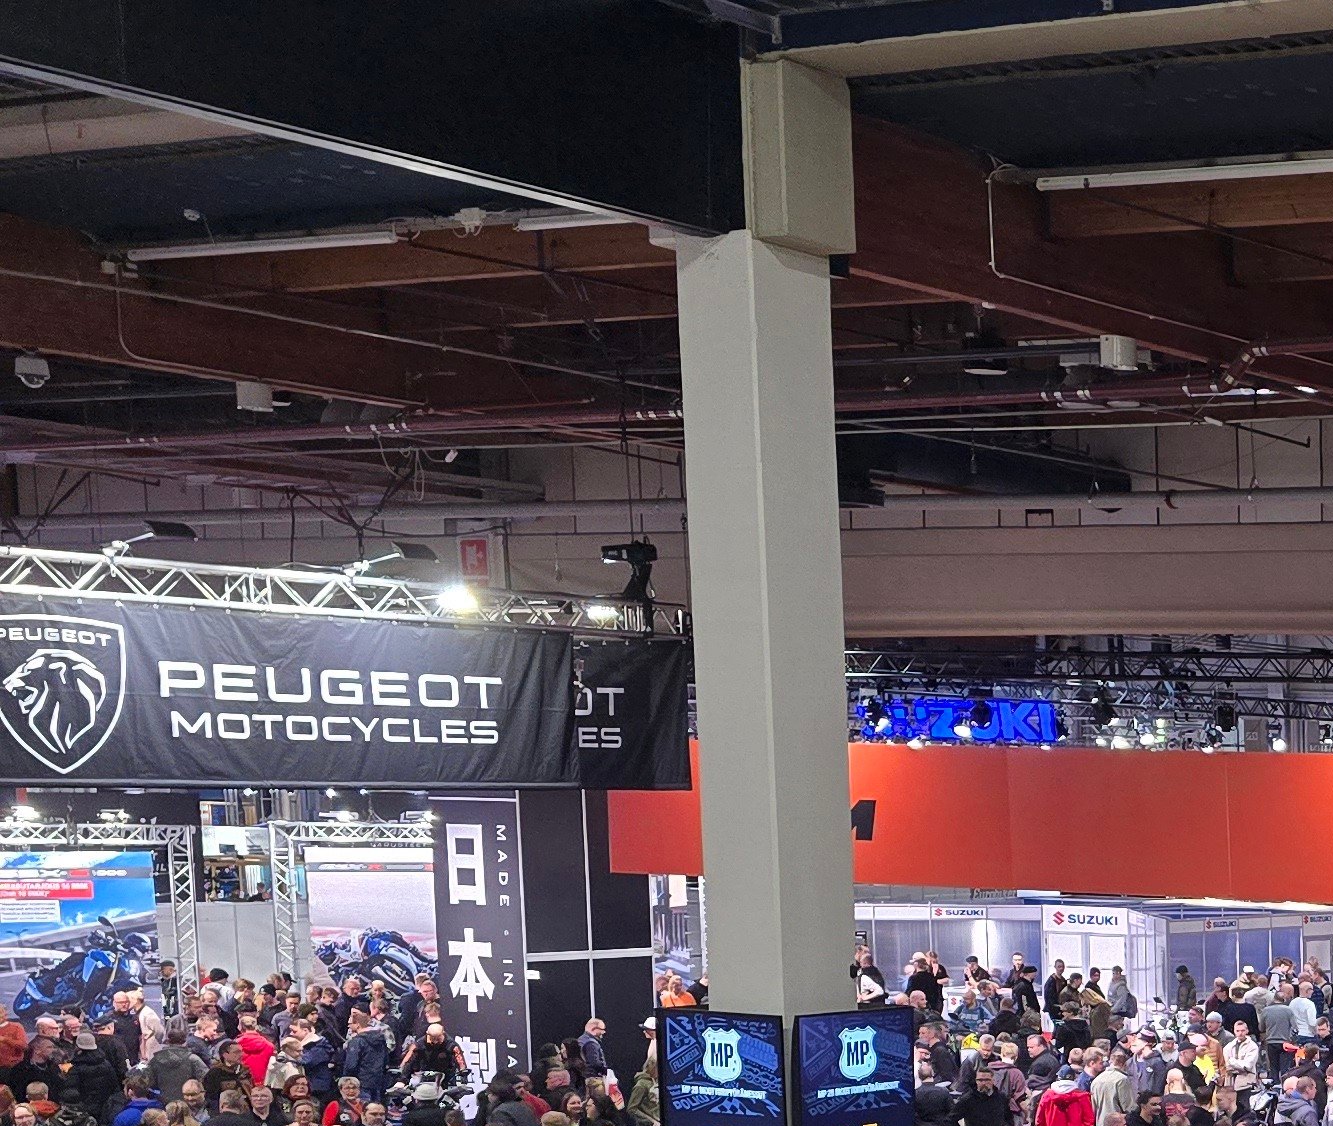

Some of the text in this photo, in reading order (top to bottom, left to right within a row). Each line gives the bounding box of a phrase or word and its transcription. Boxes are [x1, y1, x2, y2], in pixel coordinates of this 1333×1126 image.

[158, 660, 502, 710] PEUGEOT
[170, 711, 499, 744] MOTOCYCLES
[495, 825, 514, 986] MADE IN
[1067, 914, 1118, 926] SUZUKI
[1212, 920, 1237, 928] SUZUKI
[710, 1043, 733, 1067] MP
[847, 1040, 869, 1066] MP
